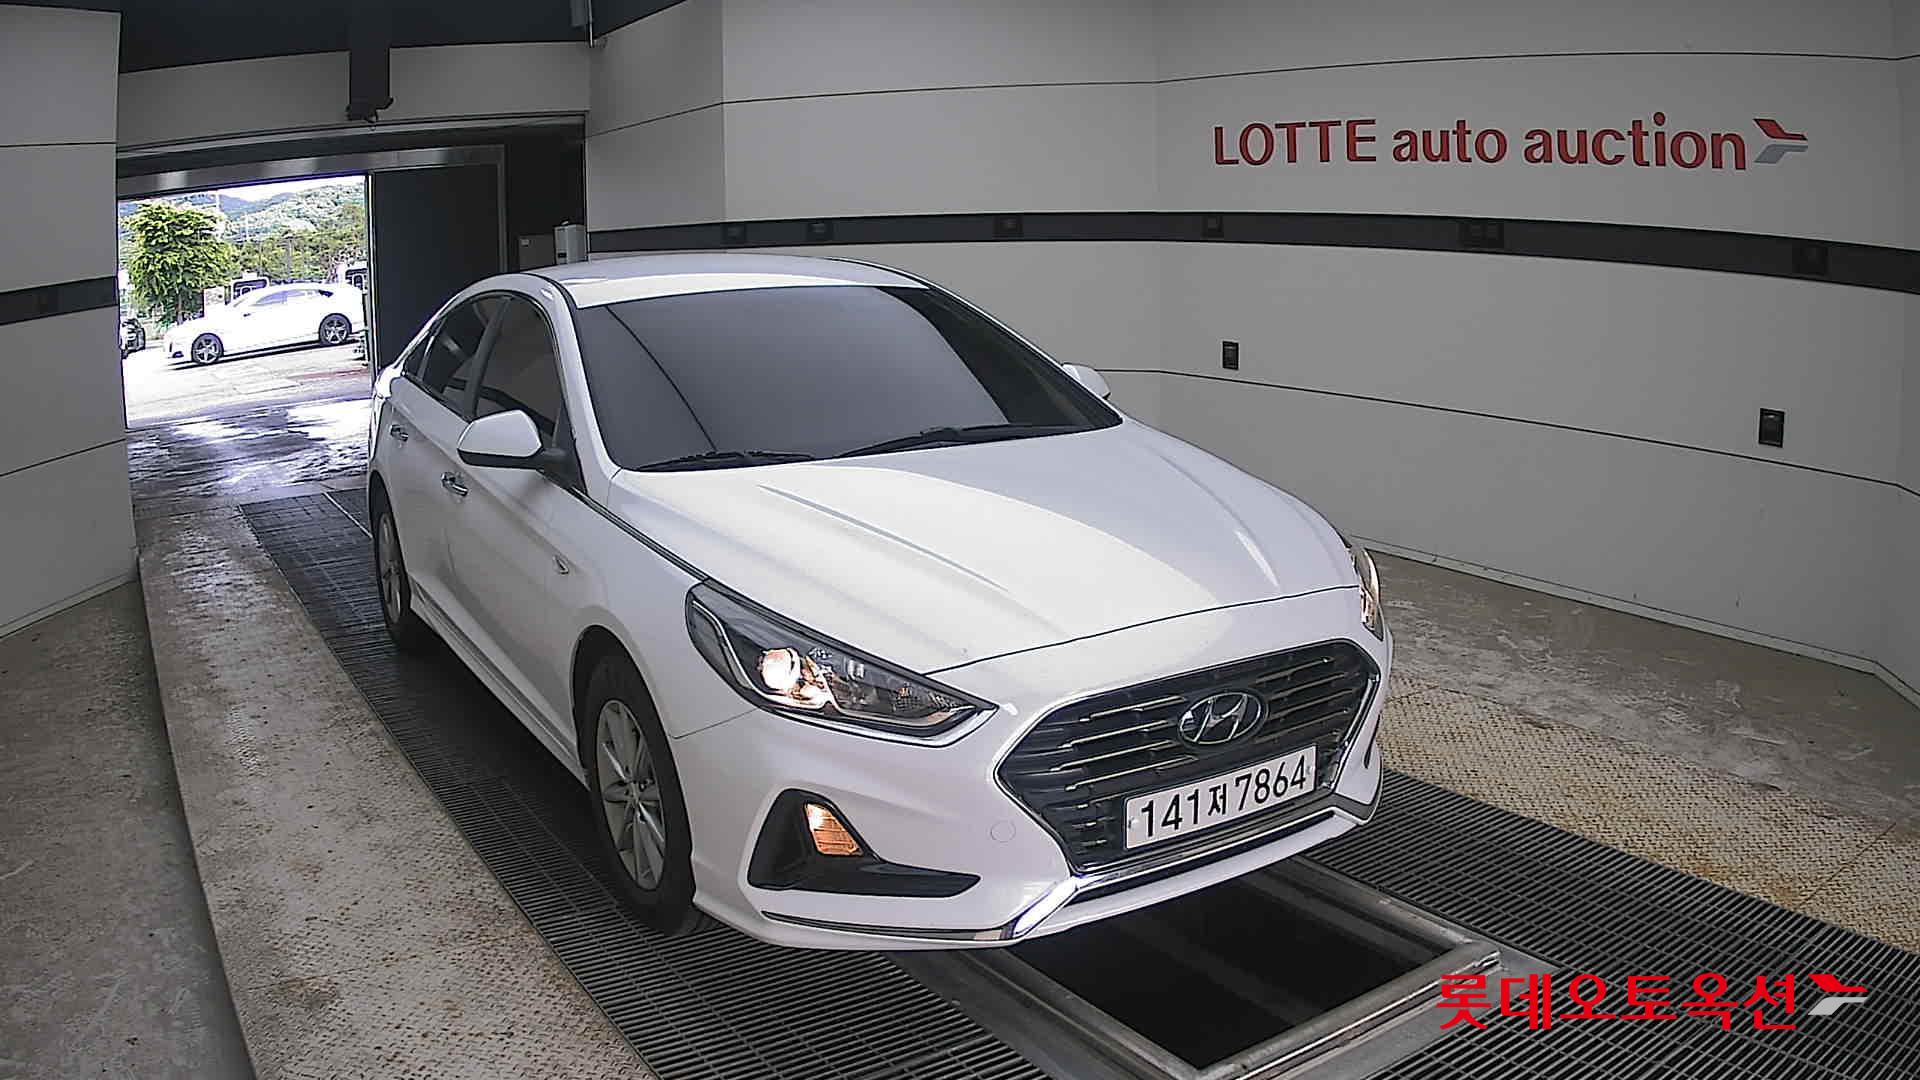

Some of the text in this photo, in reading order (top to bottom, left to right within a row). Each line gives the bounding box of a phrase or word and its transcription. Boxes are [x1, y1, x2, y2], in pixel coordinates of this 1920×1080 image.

[1214, 112, 1747, 170] LOTTE auto auction
